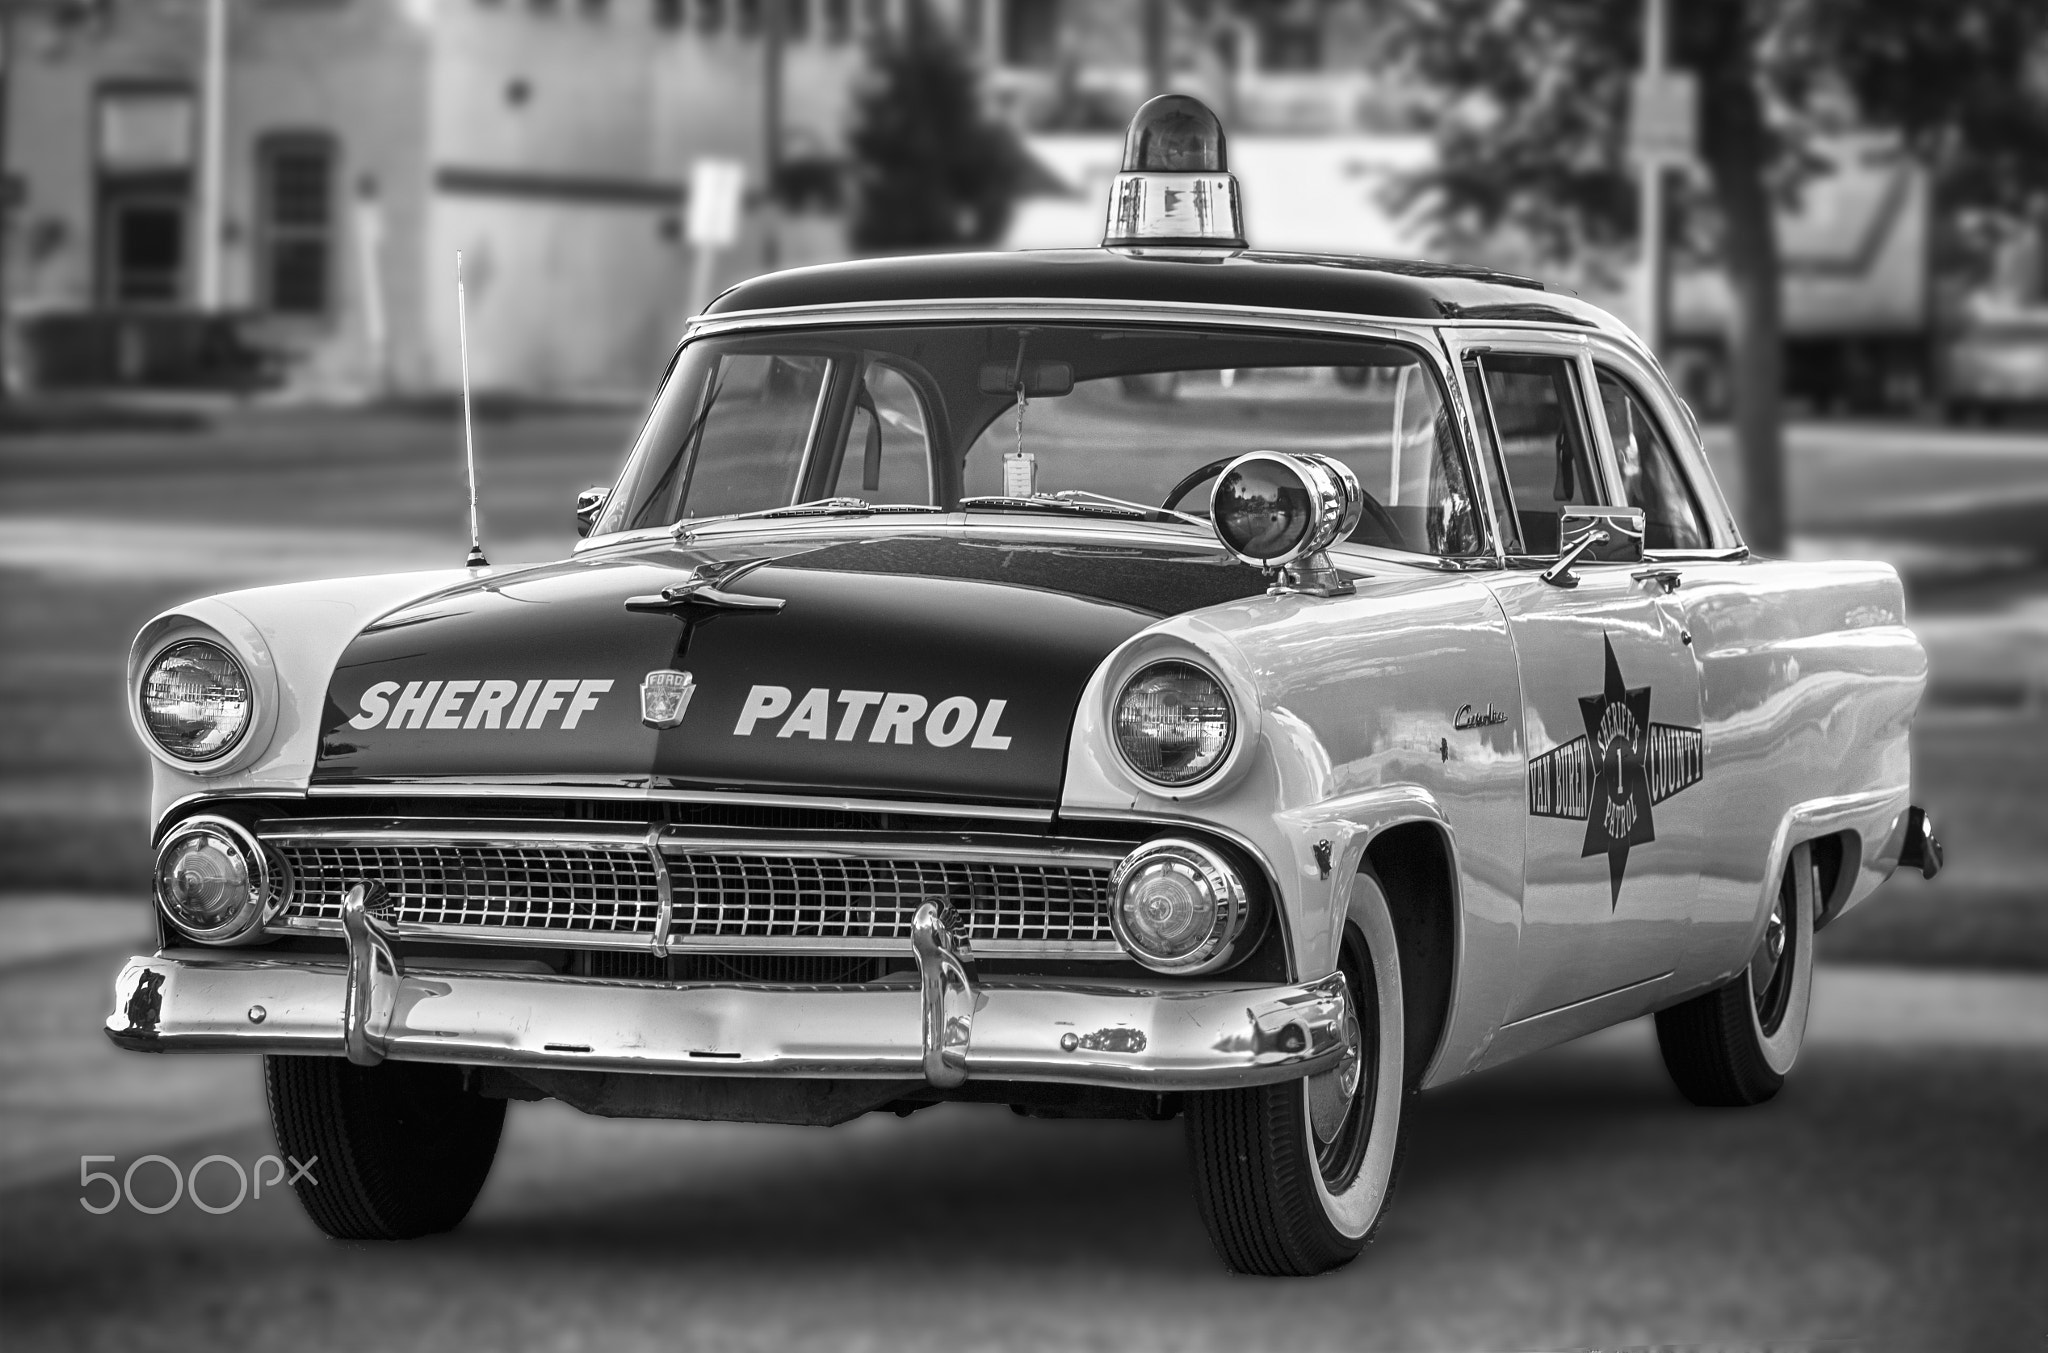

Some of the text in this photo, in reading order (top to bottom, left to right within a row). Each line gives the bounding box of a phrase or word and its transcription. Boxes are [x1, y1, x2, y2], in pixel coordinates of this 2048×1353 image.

[649, 674, 684, 686] FORD
[348, 679, 1012, 750] SHERIFF PATROL
[1597, 701, 1641, 762] SHERIFF'S
[1530, 737, 1587, 817] VAN BUREN
[1616, 748, 1624, 794] 1
[1650, 725, 1701, 802] COUNTY
[1604, 793, 1637, 839] PATROL
